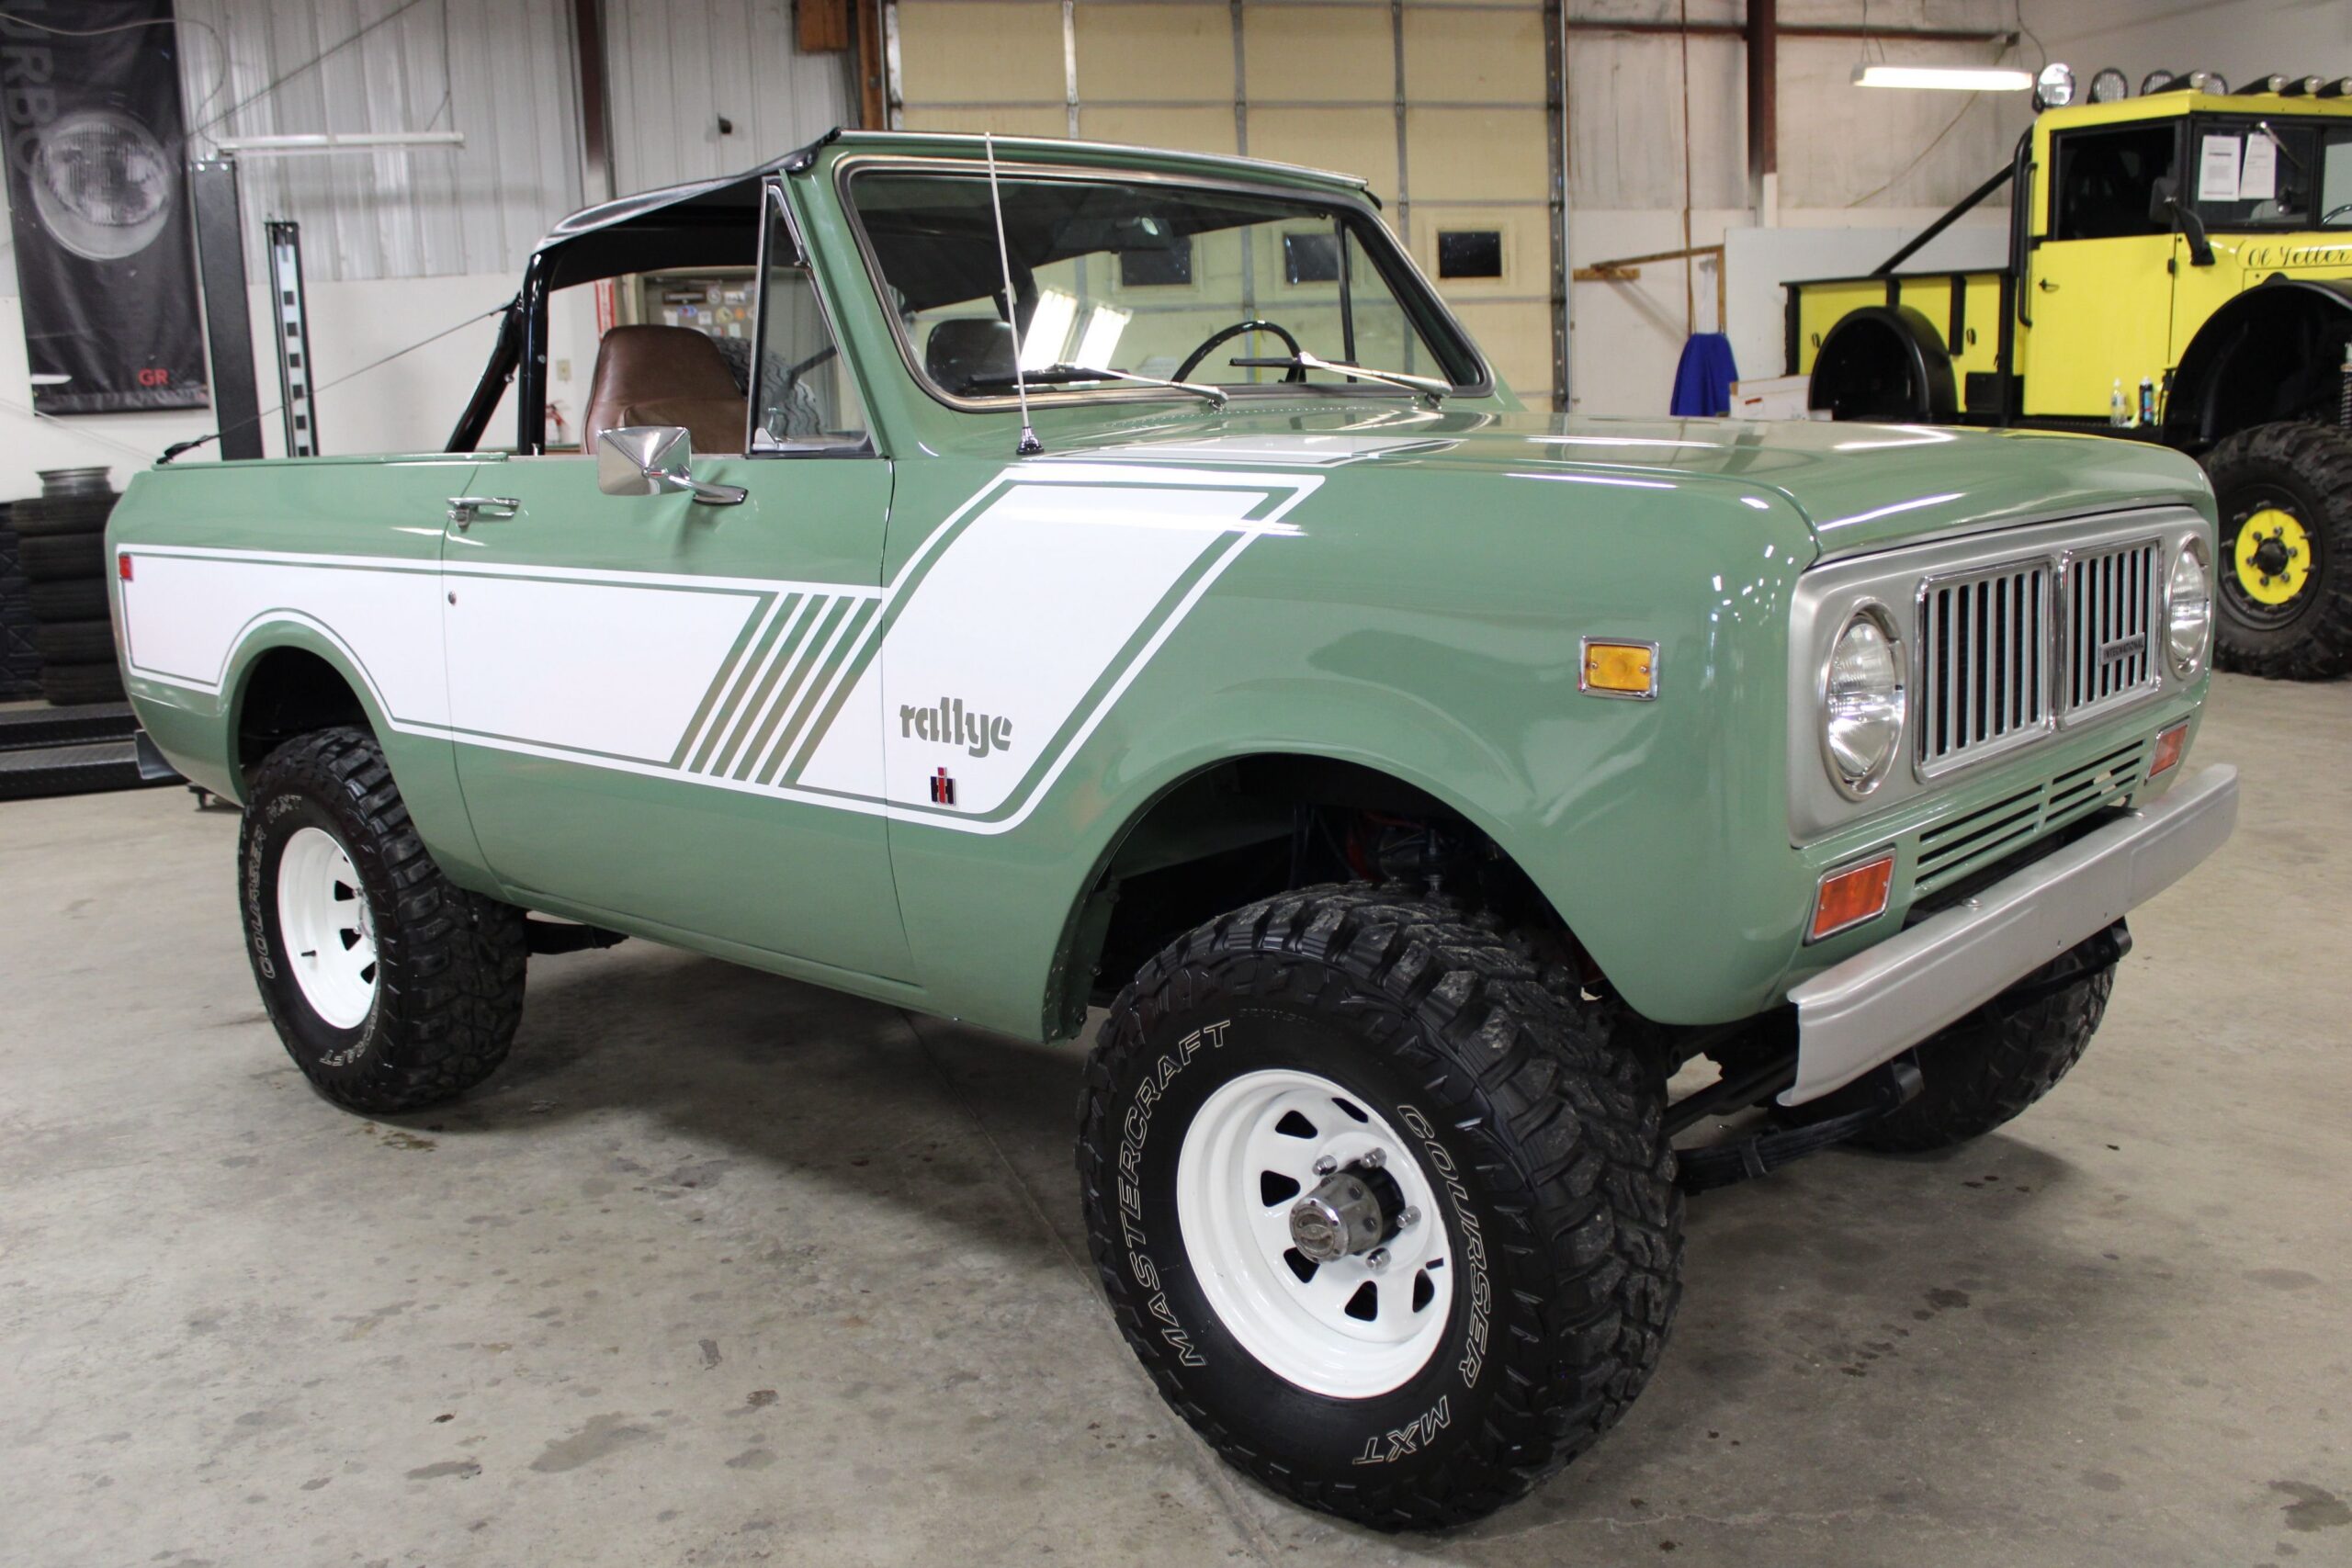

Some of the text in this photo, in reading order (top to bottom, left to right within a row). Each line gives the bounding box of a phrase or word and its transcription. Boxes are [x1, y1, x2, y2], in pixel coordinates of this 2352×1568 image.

[139, 367, 169, 386] GR
[899, 696, 1012, 758] rallye
[1117, 1020, 1231, 1367] MASTERCRAFT
[1352, 1104, 1491, 1465] COURSER MXT
